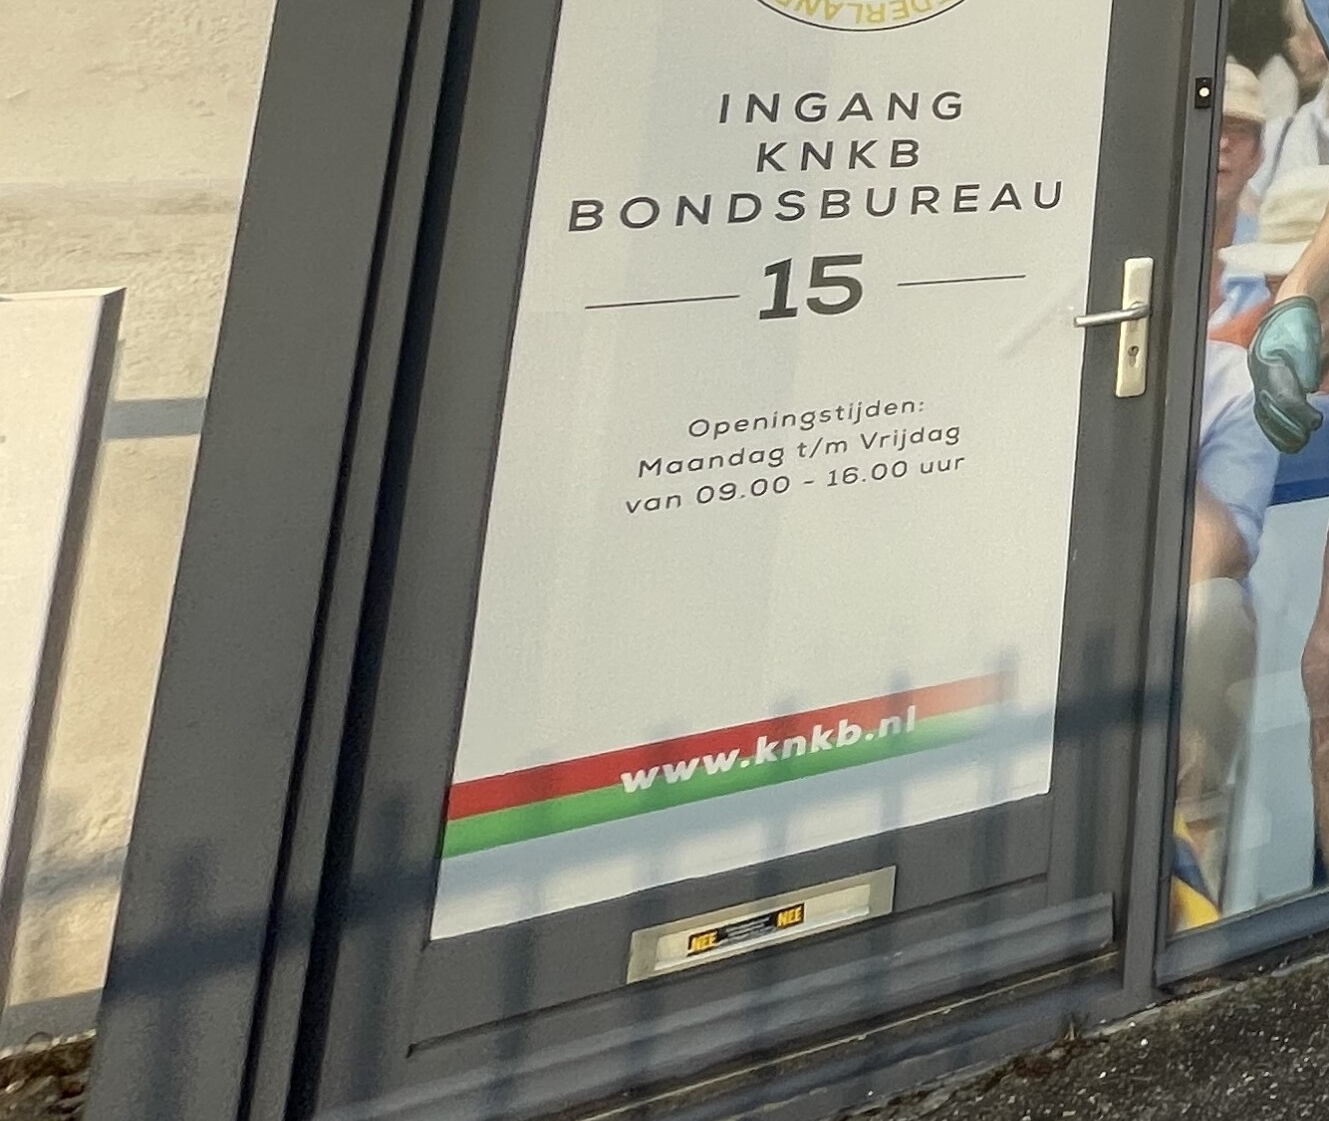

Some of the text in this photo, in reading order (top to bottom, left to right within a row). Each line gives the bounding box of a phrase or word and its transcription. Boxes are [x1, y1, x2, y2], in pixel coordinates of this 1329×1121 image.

[718, 91, 964, 124] INGANG
[756, 139, 920, 173] KNKB
[567, 181, 1063, 232] BONDSBUREAU
[758, 254, 864, 320] 15
[688, 398, 926, 440] Openingstijden:
[638, 424, 961, 478] Maandag t/m Vrijdag
[625, 492, 682, 515] van
[696, 475, 791, 505] 09.00
[827, 460, 908, 488] 16.00
[919, 454, 966, 475] uur
[620, 707, 918, 793] www.knkb.nl
[776, 905, 804, 927] NEE
